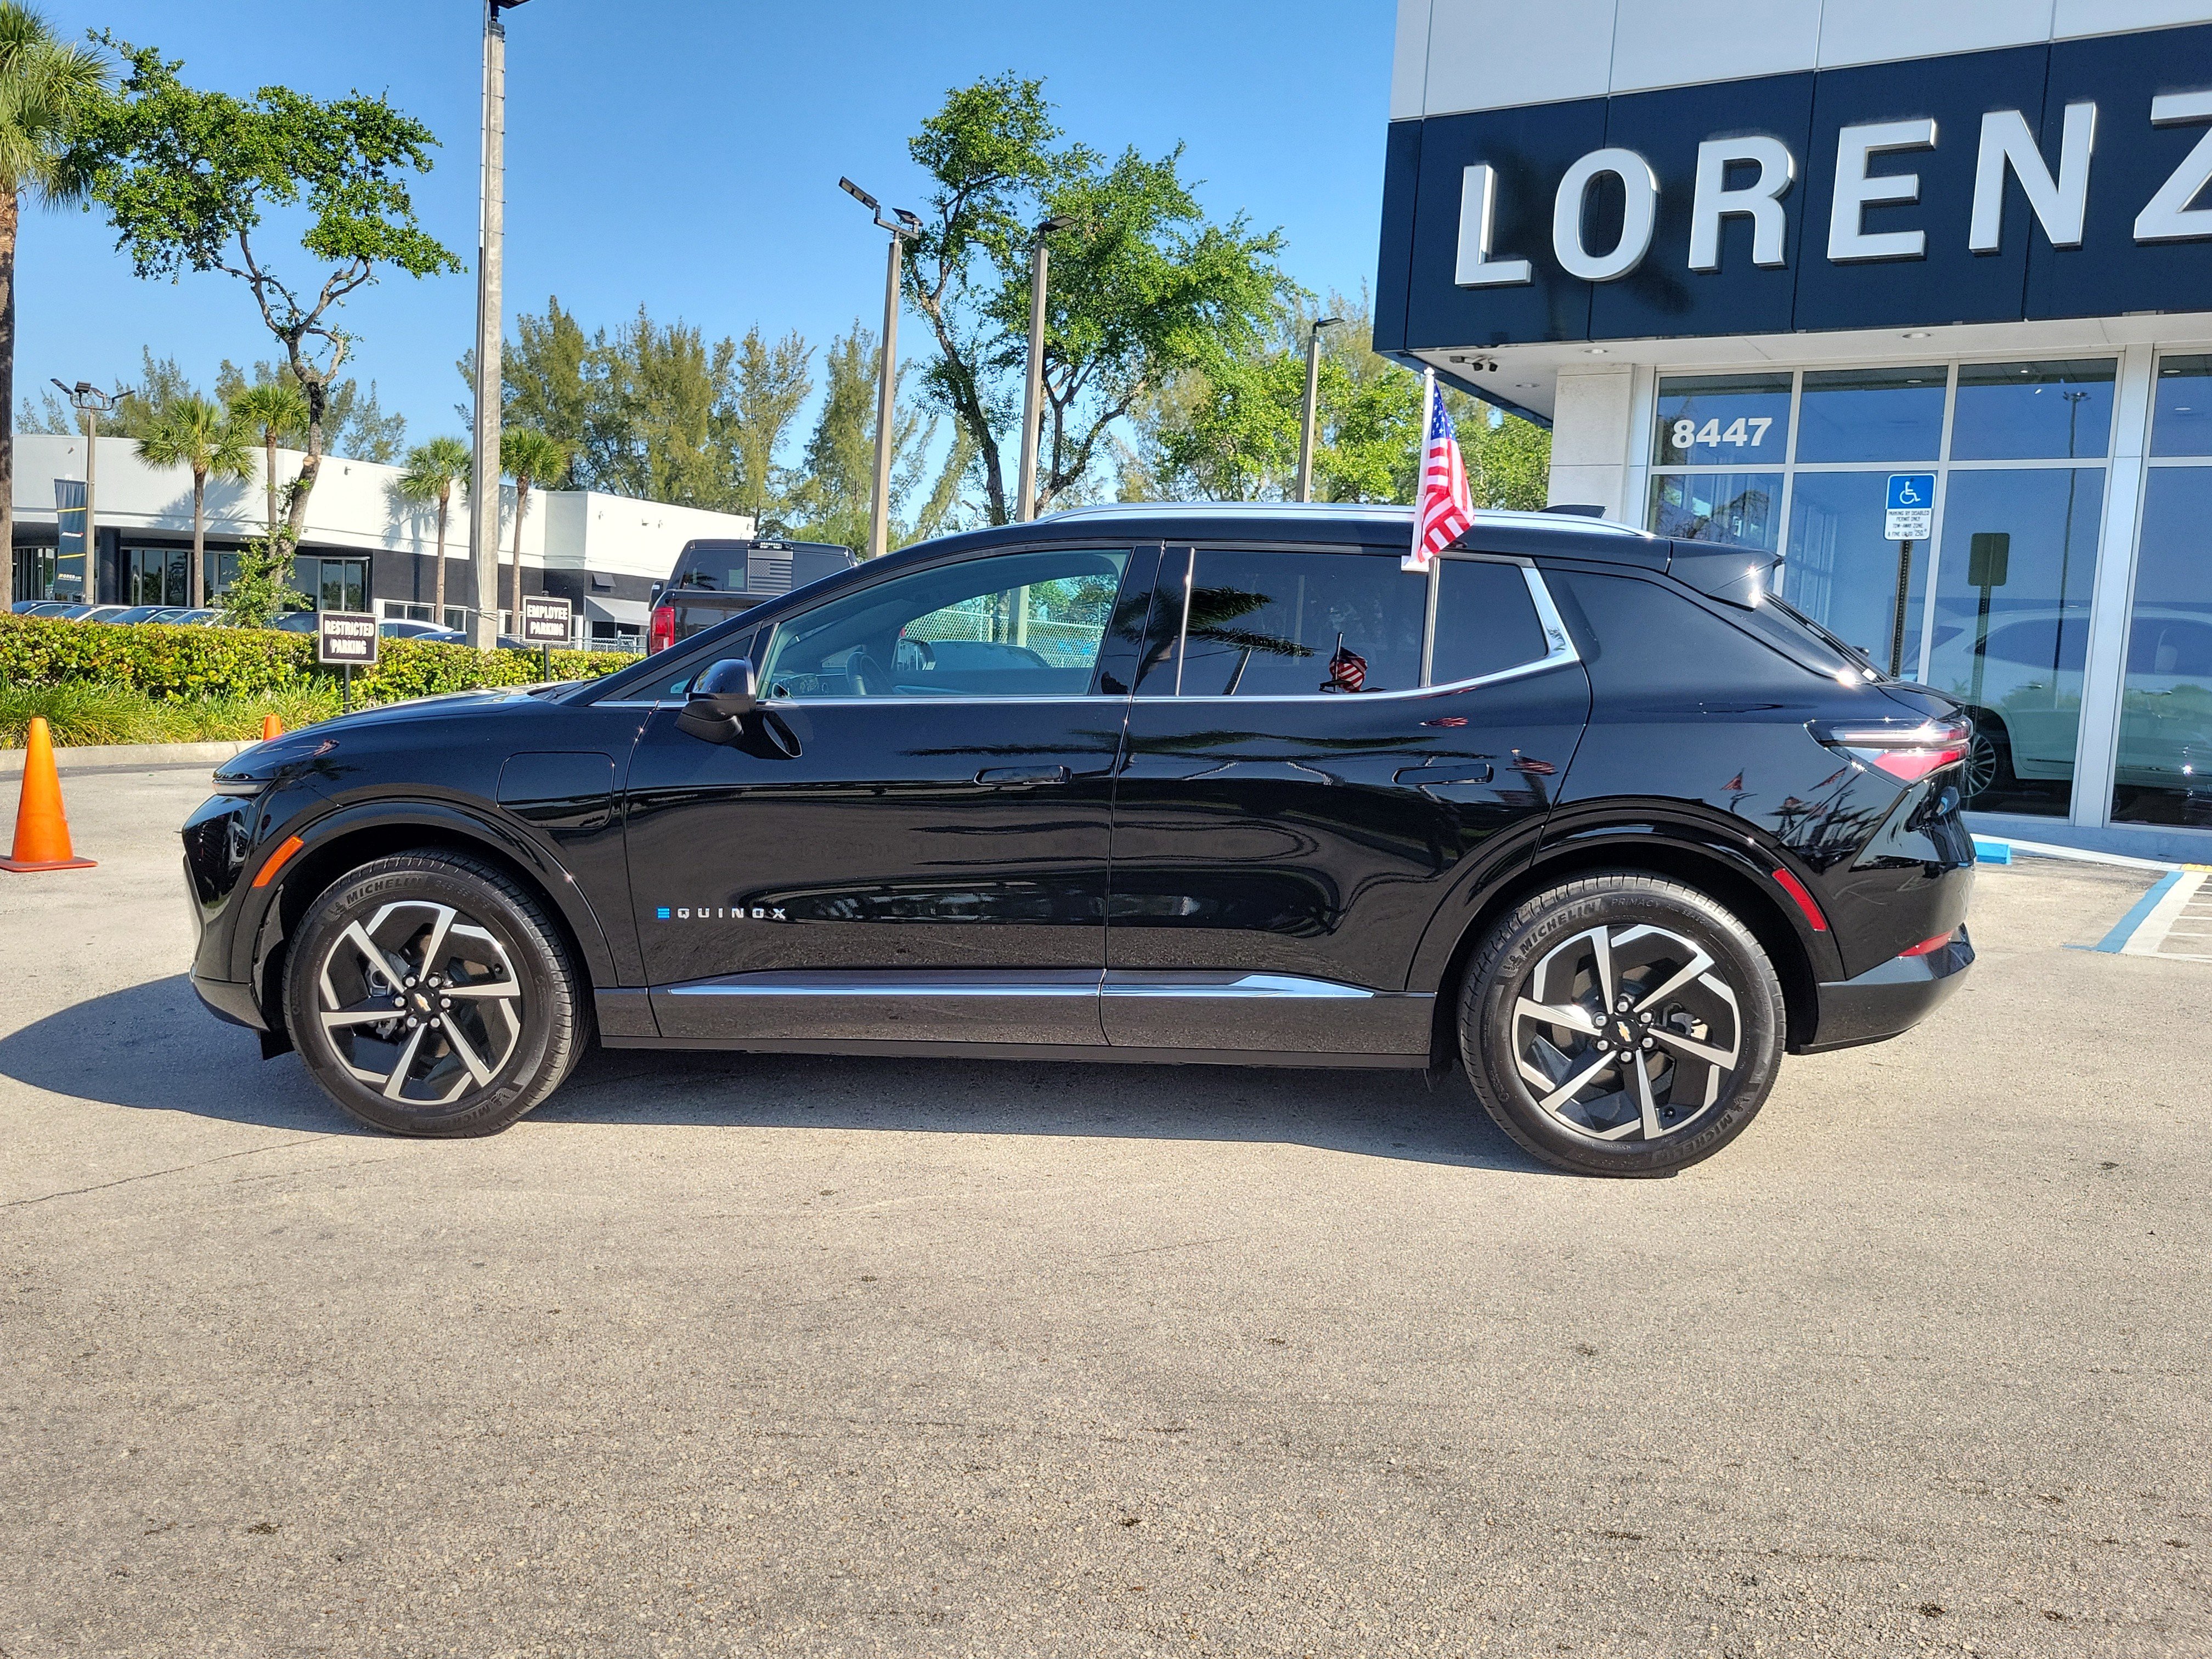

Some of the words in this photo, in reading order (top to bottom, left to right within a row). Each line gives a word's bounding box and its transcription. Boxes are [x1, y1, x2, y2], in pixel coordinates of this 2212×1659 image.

[1455, 91, 2212, 287] LORENZ
[1672, 417, 1773, 449] 8447
[527, 604, 568, 620] EMPLOYEE
[324, 619, 375, 637] RESTRICTED
[530, 621, 565, 636] PARKING
[331, 639, 367, 655] PARKING
[346, 877, 422, 905] MICHELIN
[1611, 897, 1659, 909] PRIMACY
[657, 907, 786, 919] EQUINOX
[1519, 901, 1596, 955] MICHELIN
